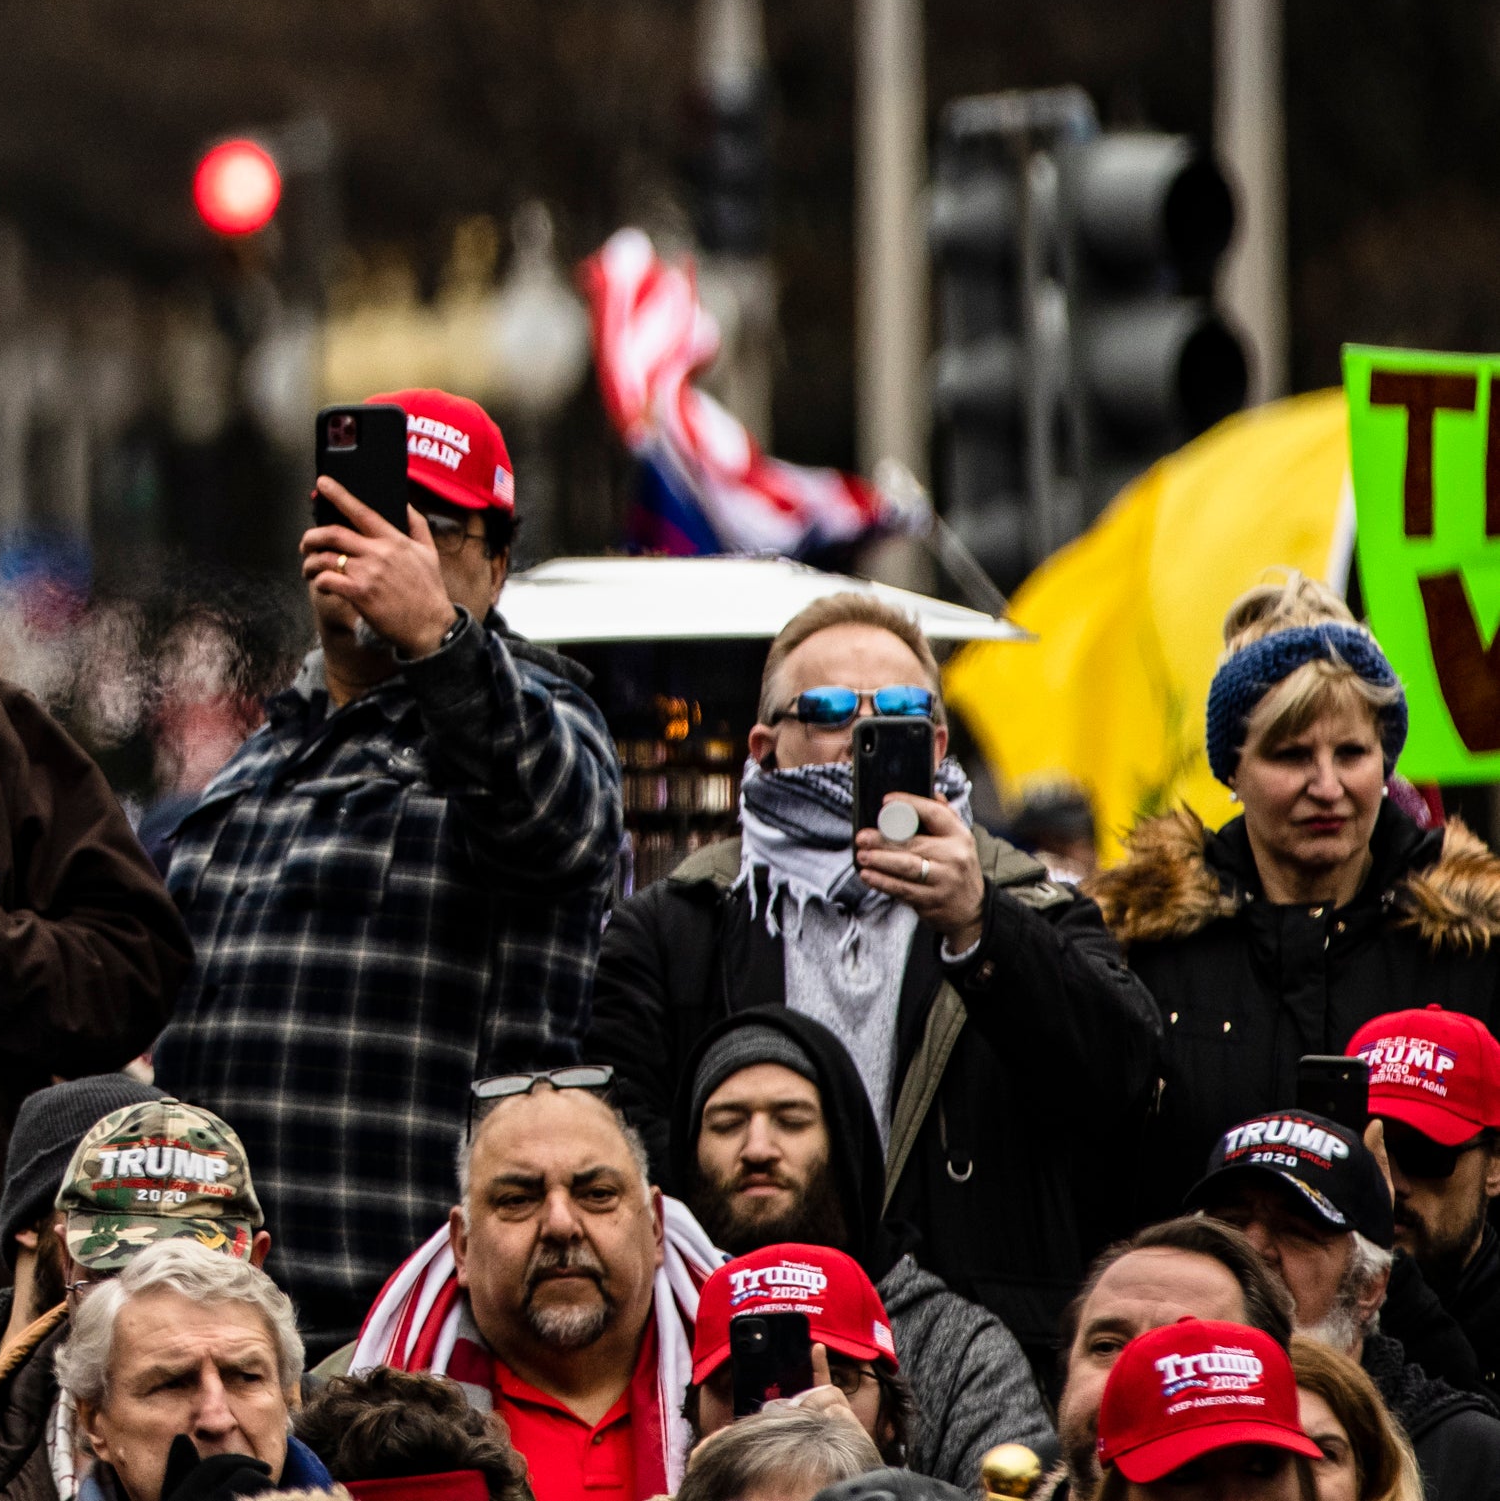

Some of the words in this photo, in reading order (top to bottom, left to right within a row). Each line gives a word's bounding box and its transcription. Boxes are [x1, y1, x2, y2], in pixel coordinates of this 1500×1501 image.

[407, 414, 471, 455] MERICA
[1377, 1062, 1410, 1076] 2020
[1422, 1080, 1448, 1097] AGAIN
[1225, 1120, 1350, 1162] TRUMP
[97, 1146, 230, 1183] TRUMP
[1249, 1151, 1298, 1168] 2020
[136, 1189, 187, 1203] 2020
[202, 1181, 234, 1198] AGAIN
[728, 1266, 828, 1297] Trump
[771, 1285, 809, 1300] 2020
[753, 1303, 794, 1315] AMERICA
[1155, 1352, 1264, 1385] Trump
[1209, 1375, 1249, 1390] 2020
[1166, 1401, 1193, 1415] KEEP
[1194, 1395, 1238, 1408] AMERICA
[1239, 1395, 1266, 1406] GREAT
